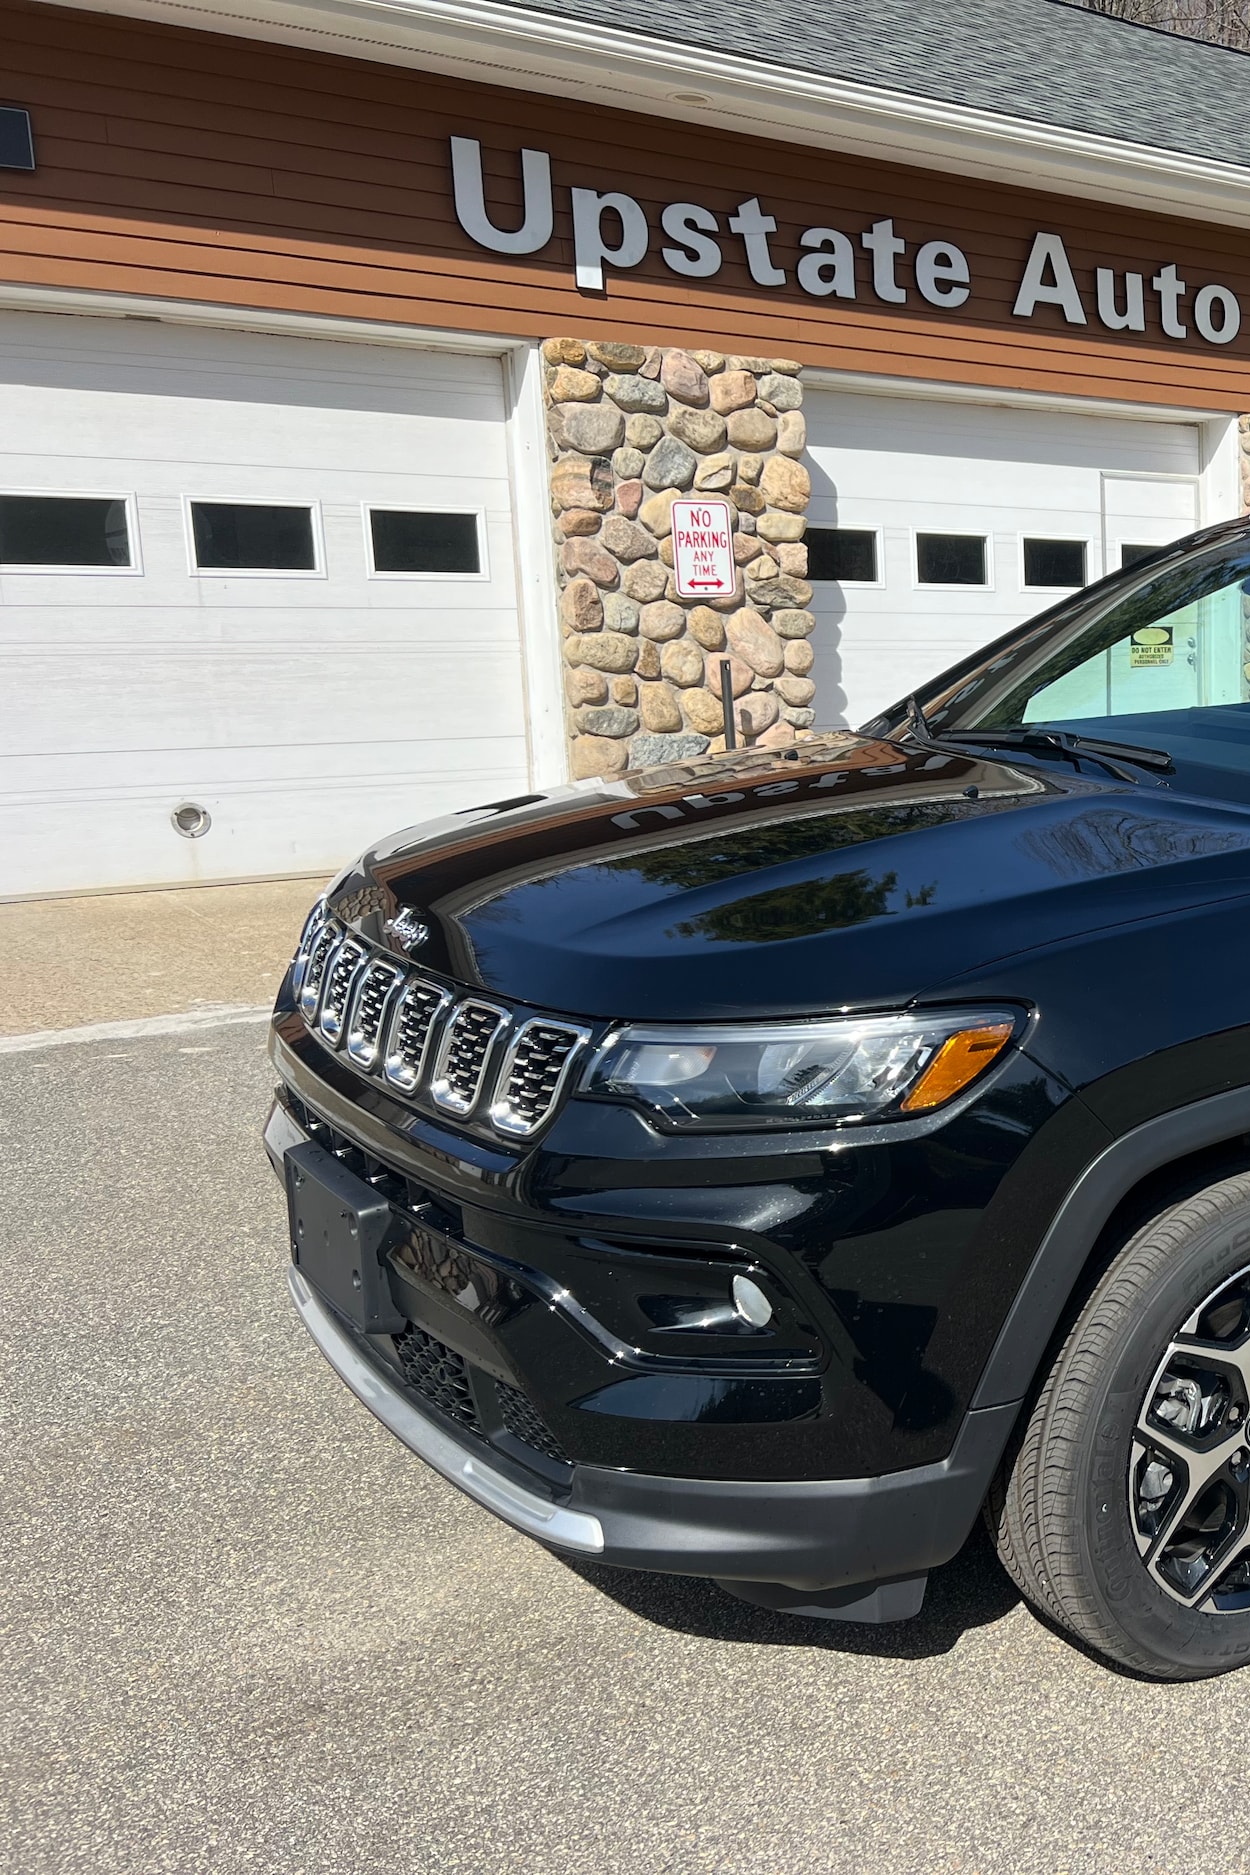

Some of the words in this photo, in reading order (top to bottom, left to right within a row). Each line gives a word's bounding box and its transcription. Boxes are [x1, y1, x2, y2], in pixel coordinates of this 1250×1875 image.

[450, 135, 970, 308] Upstate
[1012, 231, 1241, 345] Auto
[690, 510, 712, 527] NO
[678, 531, 727, 548] PARKING
[693, 551, 714, 562] ANY
[693, 564, 717, 576] TIME
